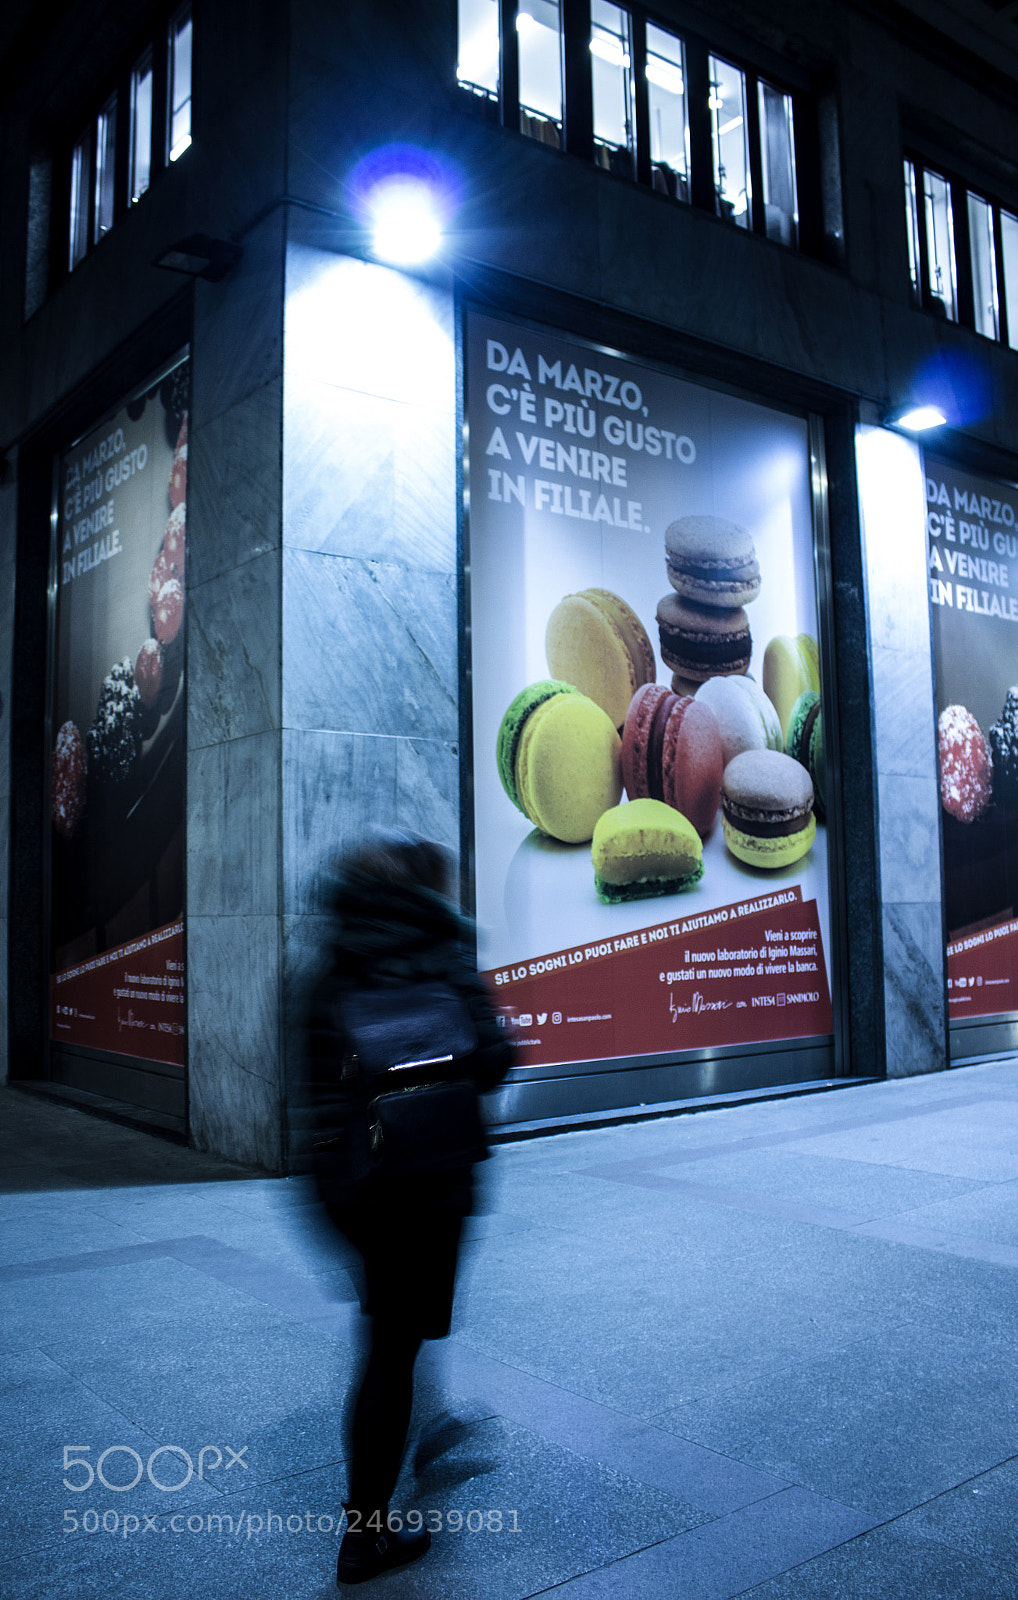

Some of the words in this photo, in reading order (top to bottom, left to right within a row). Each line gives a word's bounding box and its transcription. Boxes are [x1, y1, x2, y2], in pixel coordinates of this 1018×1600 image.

[486, 338, 532, 381] DA
[537, 353, 649, 418] MARZO,
[486, 382, 537, 424] C'È
[544, 398, 596, 438] PIÙ
[603, 415, 697, 465] GUSTO
[82, 427, 126, 479] MARZO,
[83, 470, 104, 510] PIÙ
[105, 443, 148, 492] GUSTO
[485, 426, 511, 461] A
[515, 431, 628, 488] VENIRE
[487, 468, 526, 507] IN
[534, 478, 651, 534] FILIALE.
[926, 477, 953, 508] DA
[63, 532, 72, 554] A
[73, 499, 115, 546] VENIRE
[928, 509, 957, 543] C'È
[959, 519, 990, 551] PIÙ
[62, 560, 76, 586] IN
[77, 529, 123, 577] FILIALE.
[930, 544, 944, 572] A
[944, 548, 1010, 588] VENIRE
[931, 577, 953, 607] IN
[494, 971, 510, 985] SE
[511, 966, 527, 980] LO
[528, 955, 568, 975] SOGNI
[568, 950, 583, 964] LO
[584, 942, 613, 960] PUOI
[614, 935, 640, 952] FARE
[640, 933, 647, 944] E
[648, 926, 669, 942] NOI
[669, 923, 681, 936] TI
[681, 910, 729, 932] AIUTIAMO
[729, 907, 738, 919] A
[737, 891, 798, 915] REALIZZARLO.
[684, 950, 690, 963] il
[691, 951, 716, 963] nuovo
[717, 947, 758, 962] laboratorio
[759, 946, 767, 958] di
[768, 945, 789, 961] Iginio
[789, 943, 818, 957] Massari,
[764, 929, 783, 942] Vieni
[784, 932, 790, 941] a
[790, 928, 818, 943] scoprire
[954, 943, 964, 953] LO
[963, 936, 985, 949] SOGNI
[985, 931, 994, 941] LO
[994, 925, 1010, 938] PUOI
[659, 972, 666, 982] e
[667, 967, 695, 985] gustati
[696, 969, 707, 980] un
[708, 967, 732, 979] nuovo
[733, 963, 755, 977] modo
[756, 962, 764, 976] di
[765, 962, 787, 974] vivere
[787, 960, 795, 973] la
[796, 960, 819, 972] banca.
[751, 996, 776, 1008] INTESA
